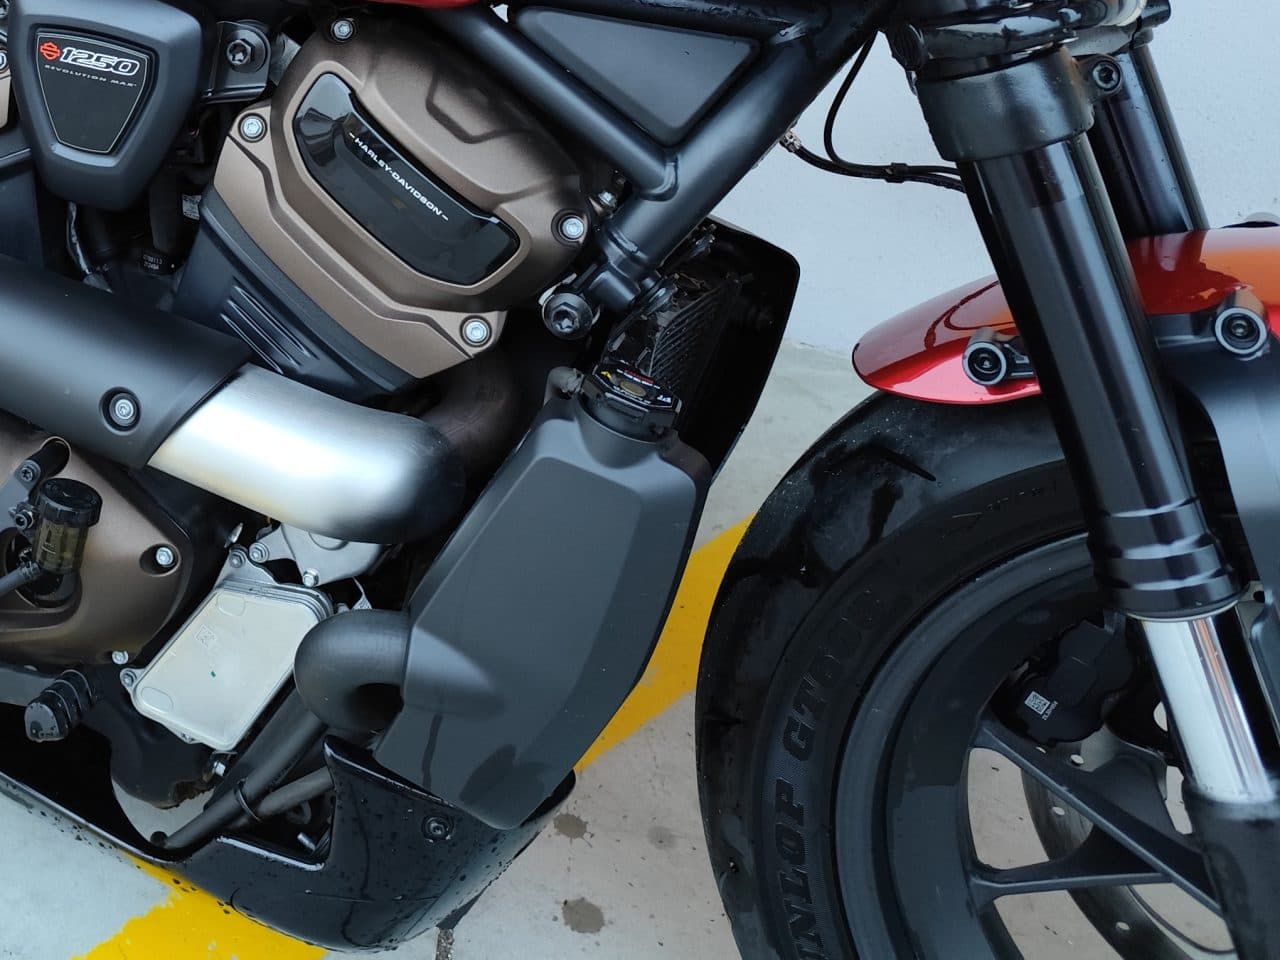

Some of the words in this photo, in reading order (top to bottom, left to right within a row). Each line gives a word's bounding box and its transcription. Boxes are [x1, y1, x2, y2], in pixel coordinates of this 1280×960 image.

[44, 64, 107, 82] REVOLUTION
[60, 47, 140, 76] 1250
[354, 137, 443, 217] HARLEY-DAVIDSON
[774, 777, 828, 960] UNLOP
